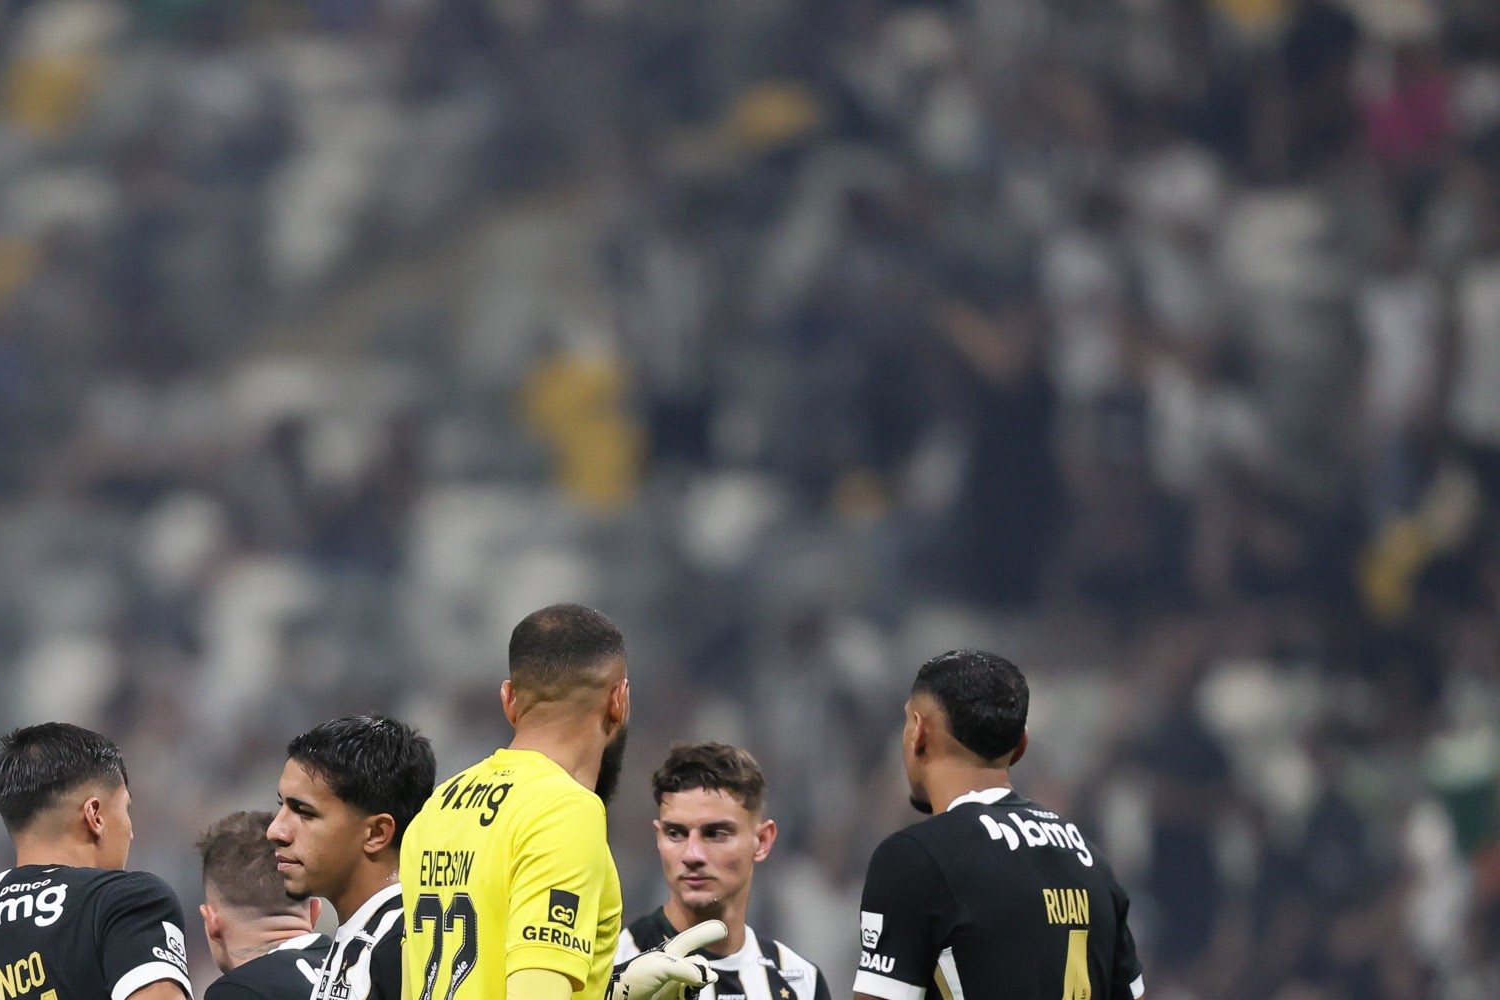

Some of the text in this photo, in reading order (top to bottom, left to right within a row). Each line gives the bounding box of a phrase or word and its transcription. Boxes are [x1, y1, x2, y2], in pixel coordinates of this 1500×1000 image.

[1008, 812, 1094, 867] bmg
[420, 850, 475, 887] EVERSON
[1043, 888, 1090, 924] RUAN
[522, 926, 591, 954] GERDAU
[331, 985, 348, 999] CAM
